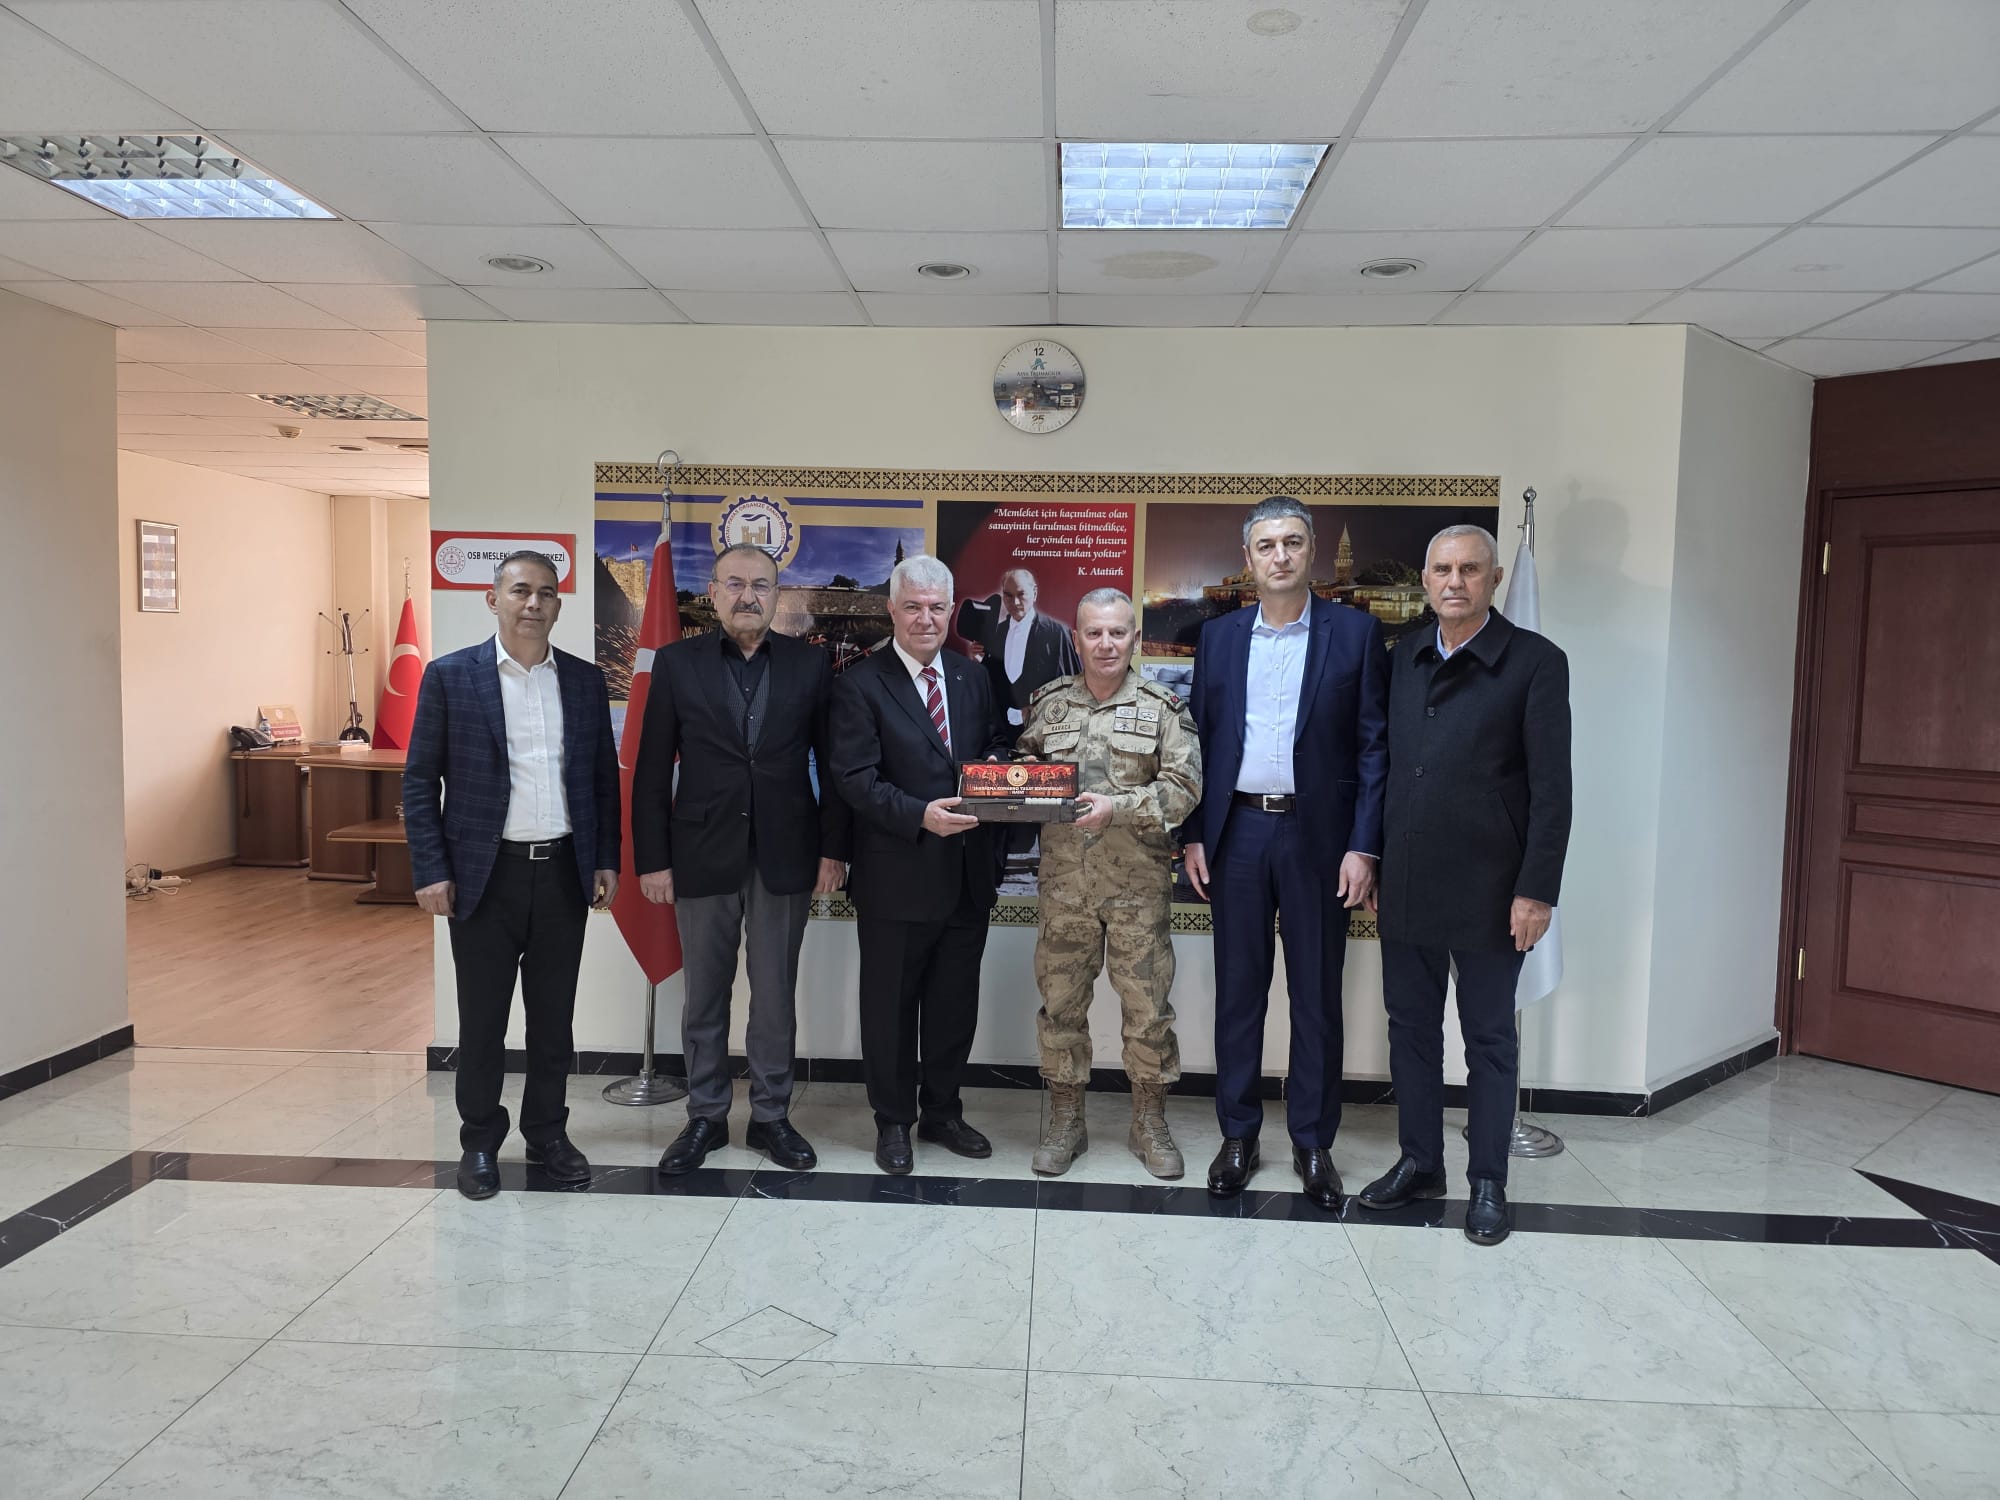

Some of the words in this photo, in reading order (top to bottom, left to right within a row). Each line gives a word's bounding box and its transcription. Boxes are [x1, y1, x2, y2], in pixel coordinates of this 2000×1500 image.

[1033, 347, 1045, 356] 12
[1041, 508, 1057, 519] için
[1059, 508, 1107, 519] kaçınılmaz
[1108, 509, 1128, 519] olan
[988, 521, 1031, 534] sanayinin
[1033, 521, 1077, 532] kurulması
[1079, 522, 1128, 534] bitmedikçe,
[1026, 534, 1041, 544] her
[1041, 535, 1073, 547] yönden
[1075, 535, 1094, 548] kalp
[1095, 535, 1128, 545] huzuru
[467, 551, 481, 560] OSB
[1012, 548, 1062, 560] duymamıza
[1063, 548, 1091, 558] imkan
[1077, 566, 1088, 576] K.
[1089, 566, 1125, 576] Atatürk
